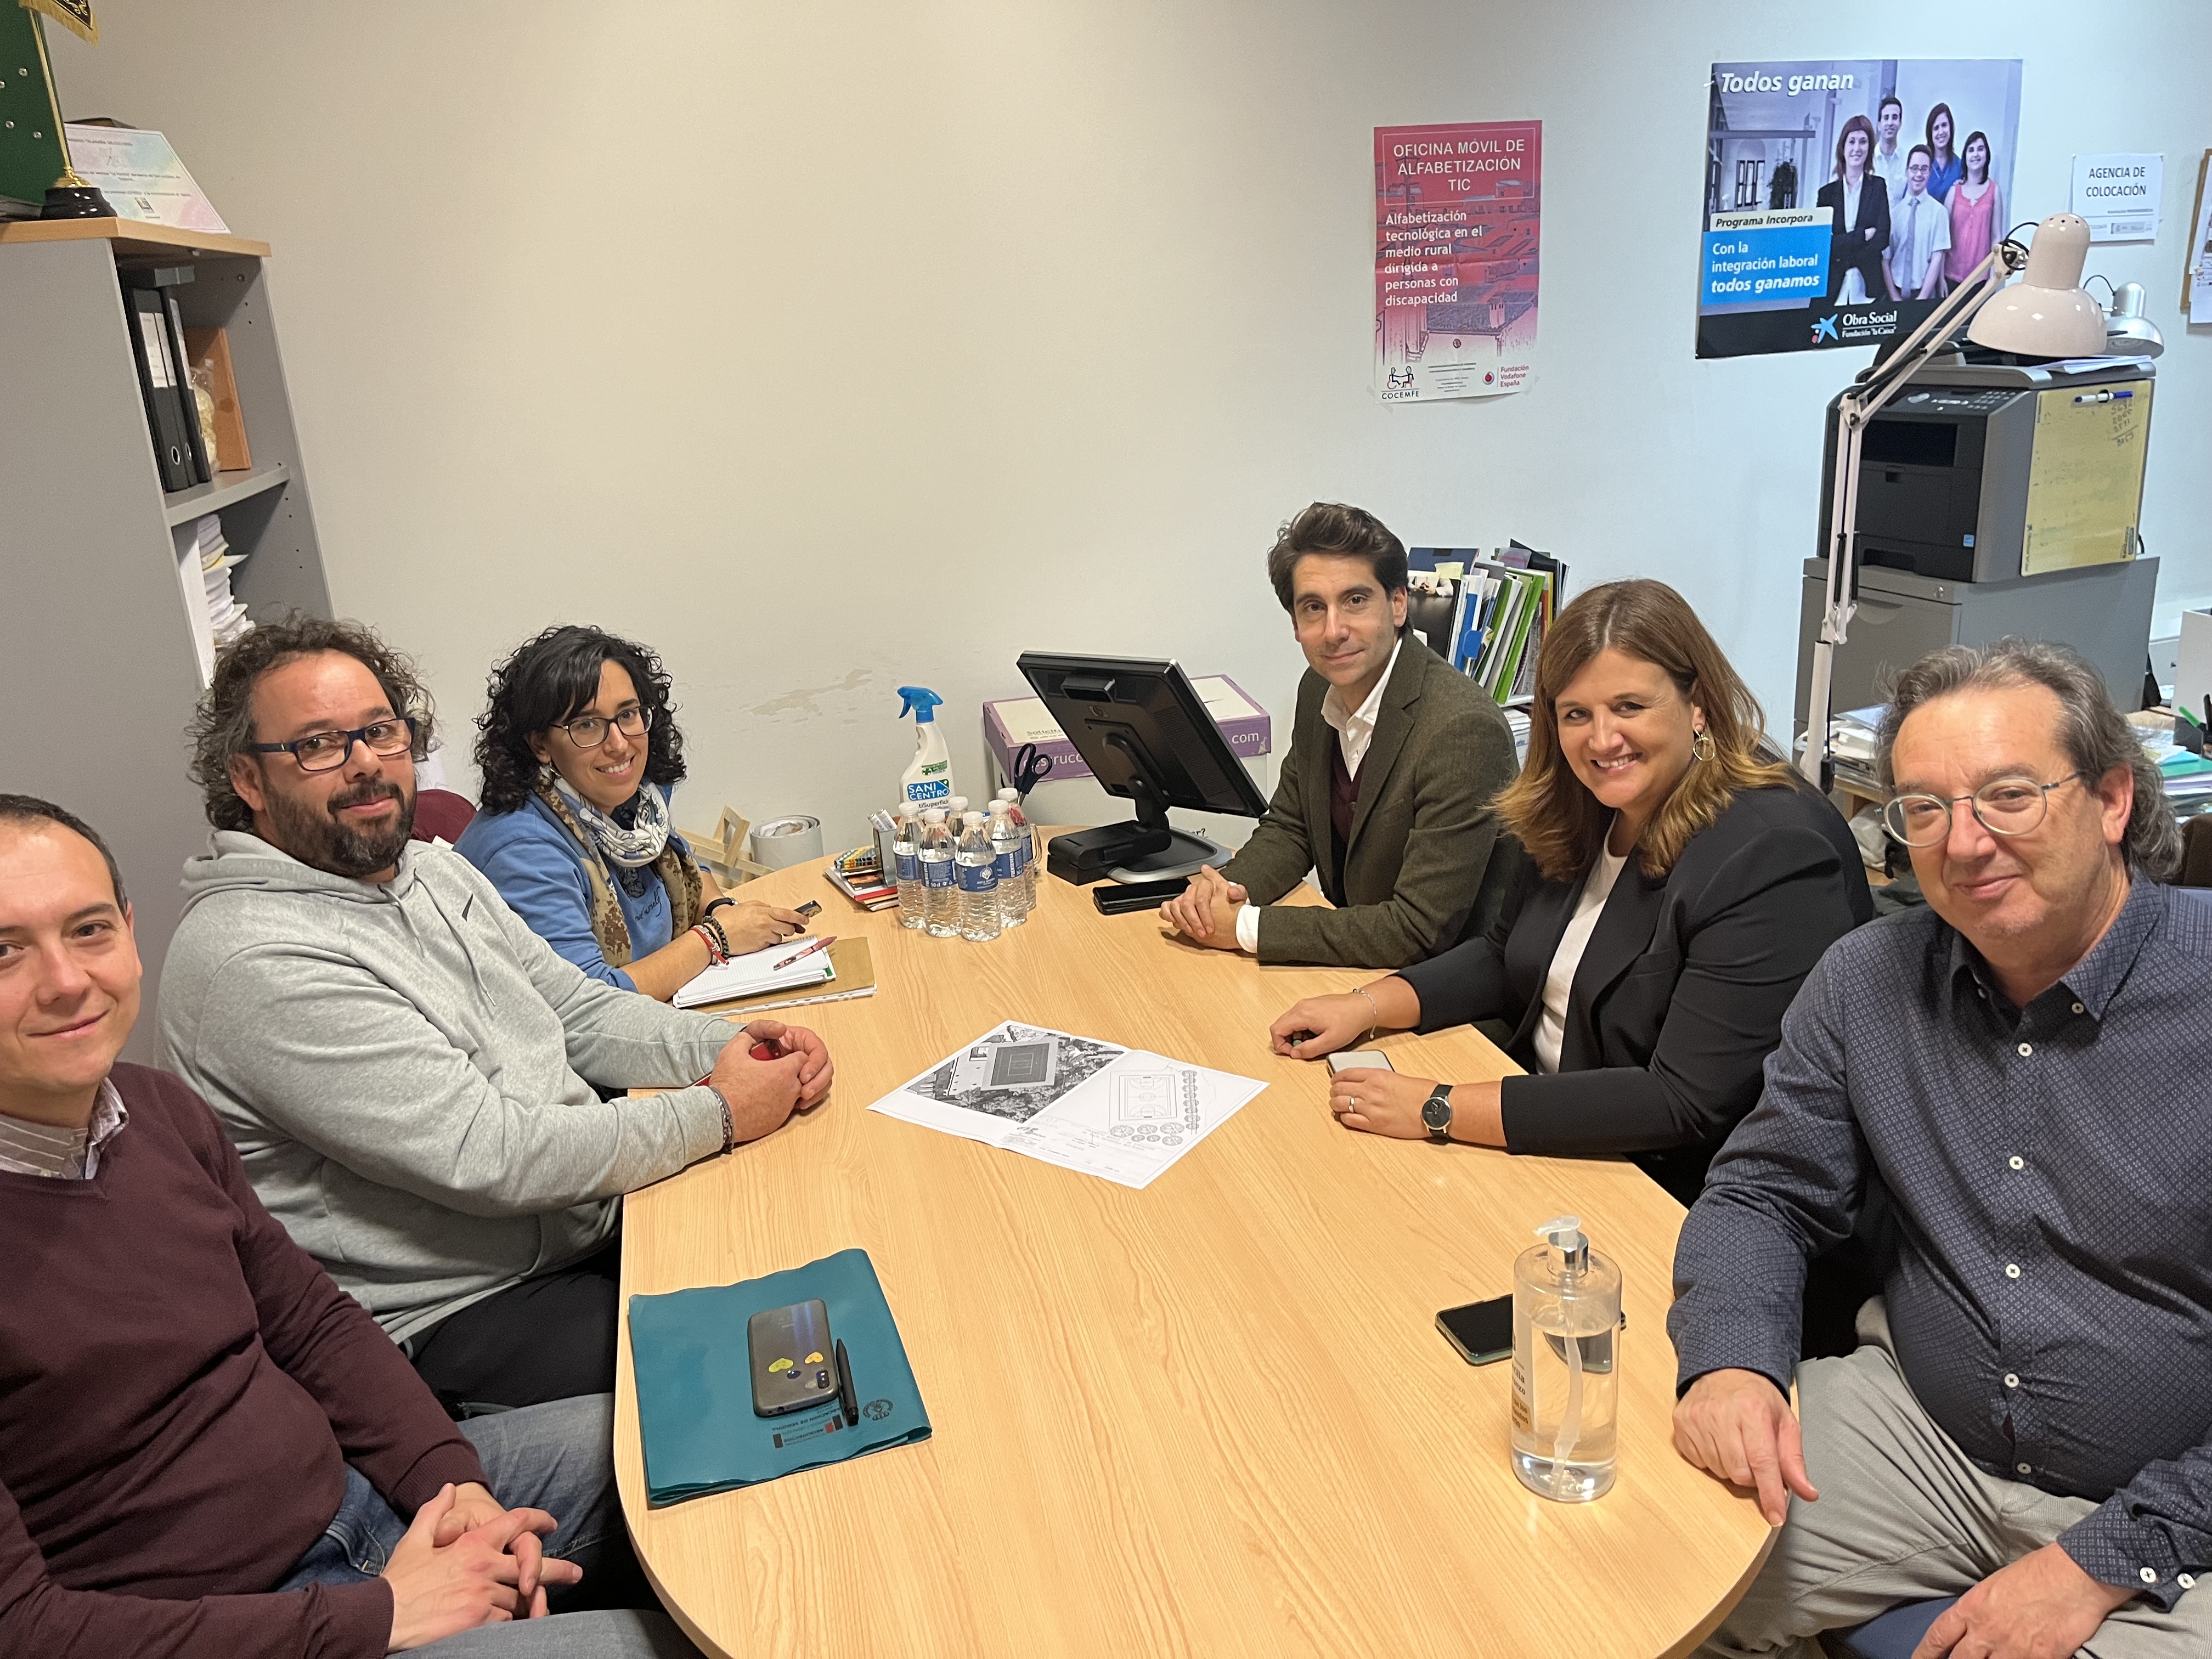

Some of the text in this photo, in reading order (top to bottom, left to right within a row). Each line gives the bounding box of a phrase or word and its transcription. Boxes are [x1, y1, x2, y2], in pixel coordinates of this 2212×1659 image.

[1721, 71, 1854, 96] Todos ganan
[1393, 138, 1525, 157] OFICINA MÓVIL DE
[1398, 155, 1521, 176] ALFABETIZACIÓN
[2089, 167, 2146, 178] AGENCIA DE
[1448, 178, 1471, 191] TIC
[2086, 183, 2147, 197] COLOCACIÓN
[1385, 210, 1467, 225] Alfabetización
[1716, 213, 1813, 229] Programa Incorpora
[1385, 225, 1482, 242] tecnológica en el
[1385, 244, 1452, 258] medio rural
[1712, 241, 1748, 255] Con la
[1384, 262, 1438, 275] dirigida a
[1712, 254, 1818, 274] integración laboral
[1385, 277, 1459, 292] personas con
[1711, 275, 1820, 294] todos ganamos
[1385, 291, 1458, 307] discapacidad
[1842, 310, 1897, 326] Obra Social
[1500, 365, 1530, 373] Fundación
[1381, 391, 1419, 399] COCEMFE
[908, 783, 936, 793] SANI
[910, 788, 949, 800] CENTRO
